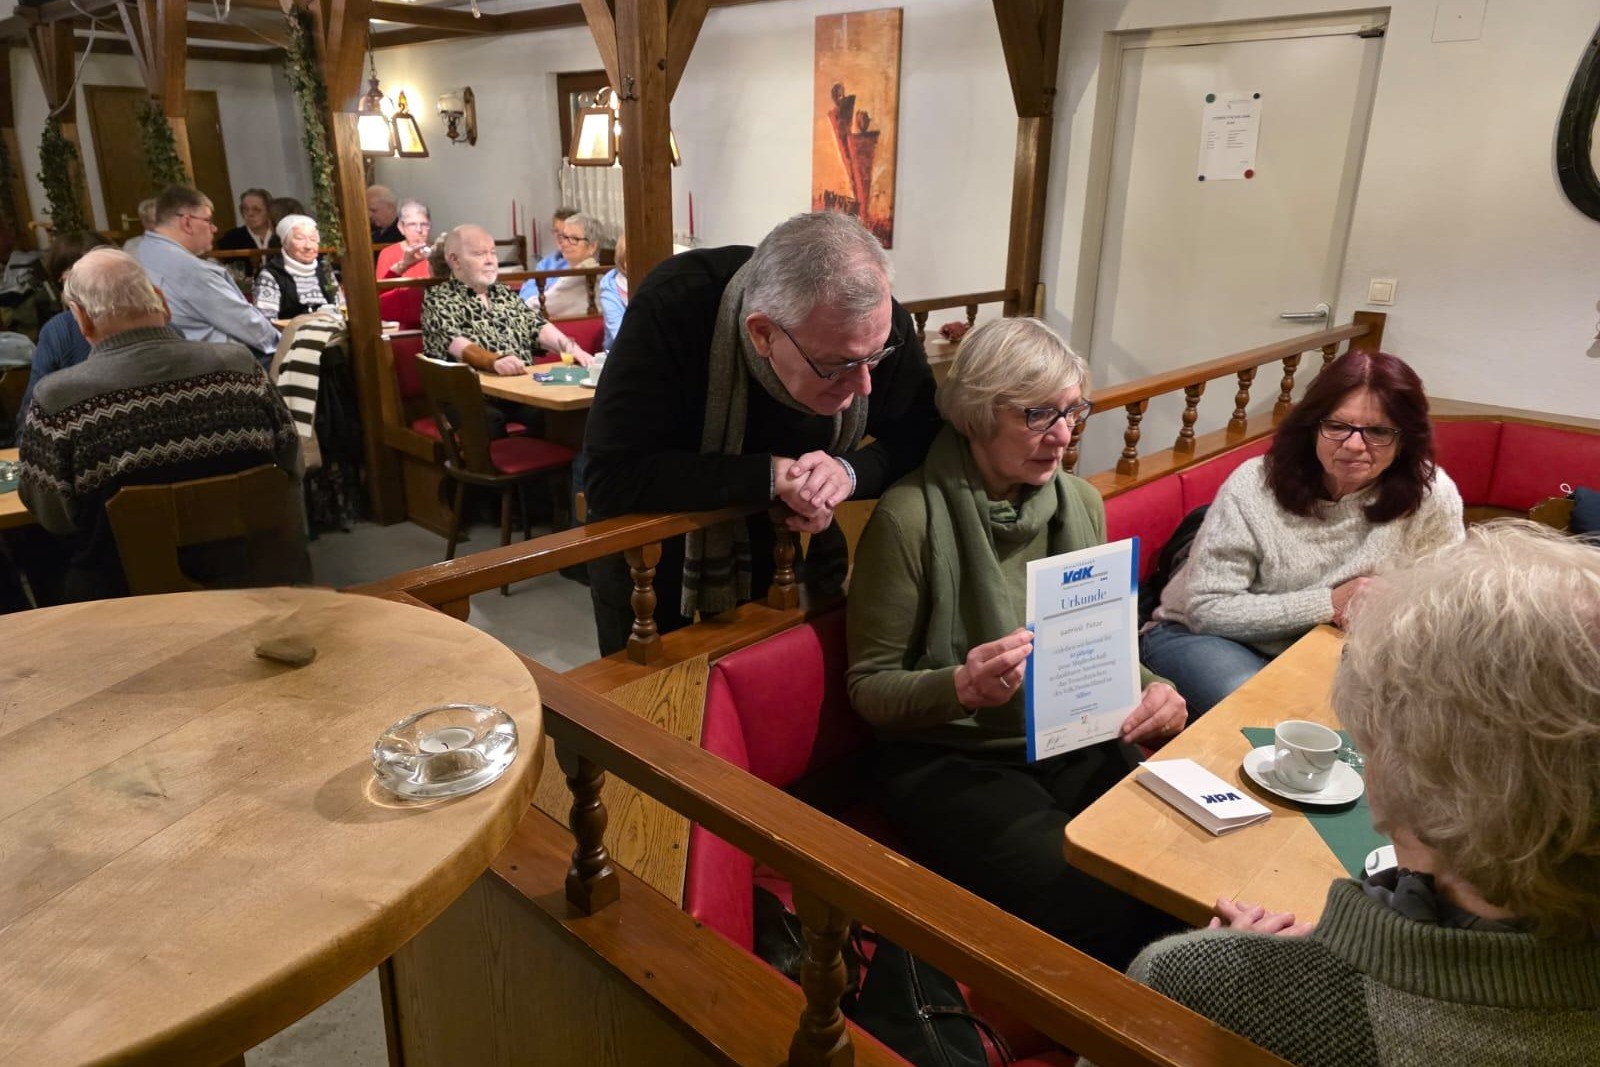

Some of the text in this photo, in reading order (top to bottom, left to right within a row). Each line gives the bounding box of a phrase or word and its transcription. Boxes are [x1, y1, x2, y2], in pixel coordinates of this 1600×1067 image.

[1063, 565, 1094, 584] VdK
[1061, 588, 1107, 609] Urkunde
[1200, 792, 1242, 804] VdK
